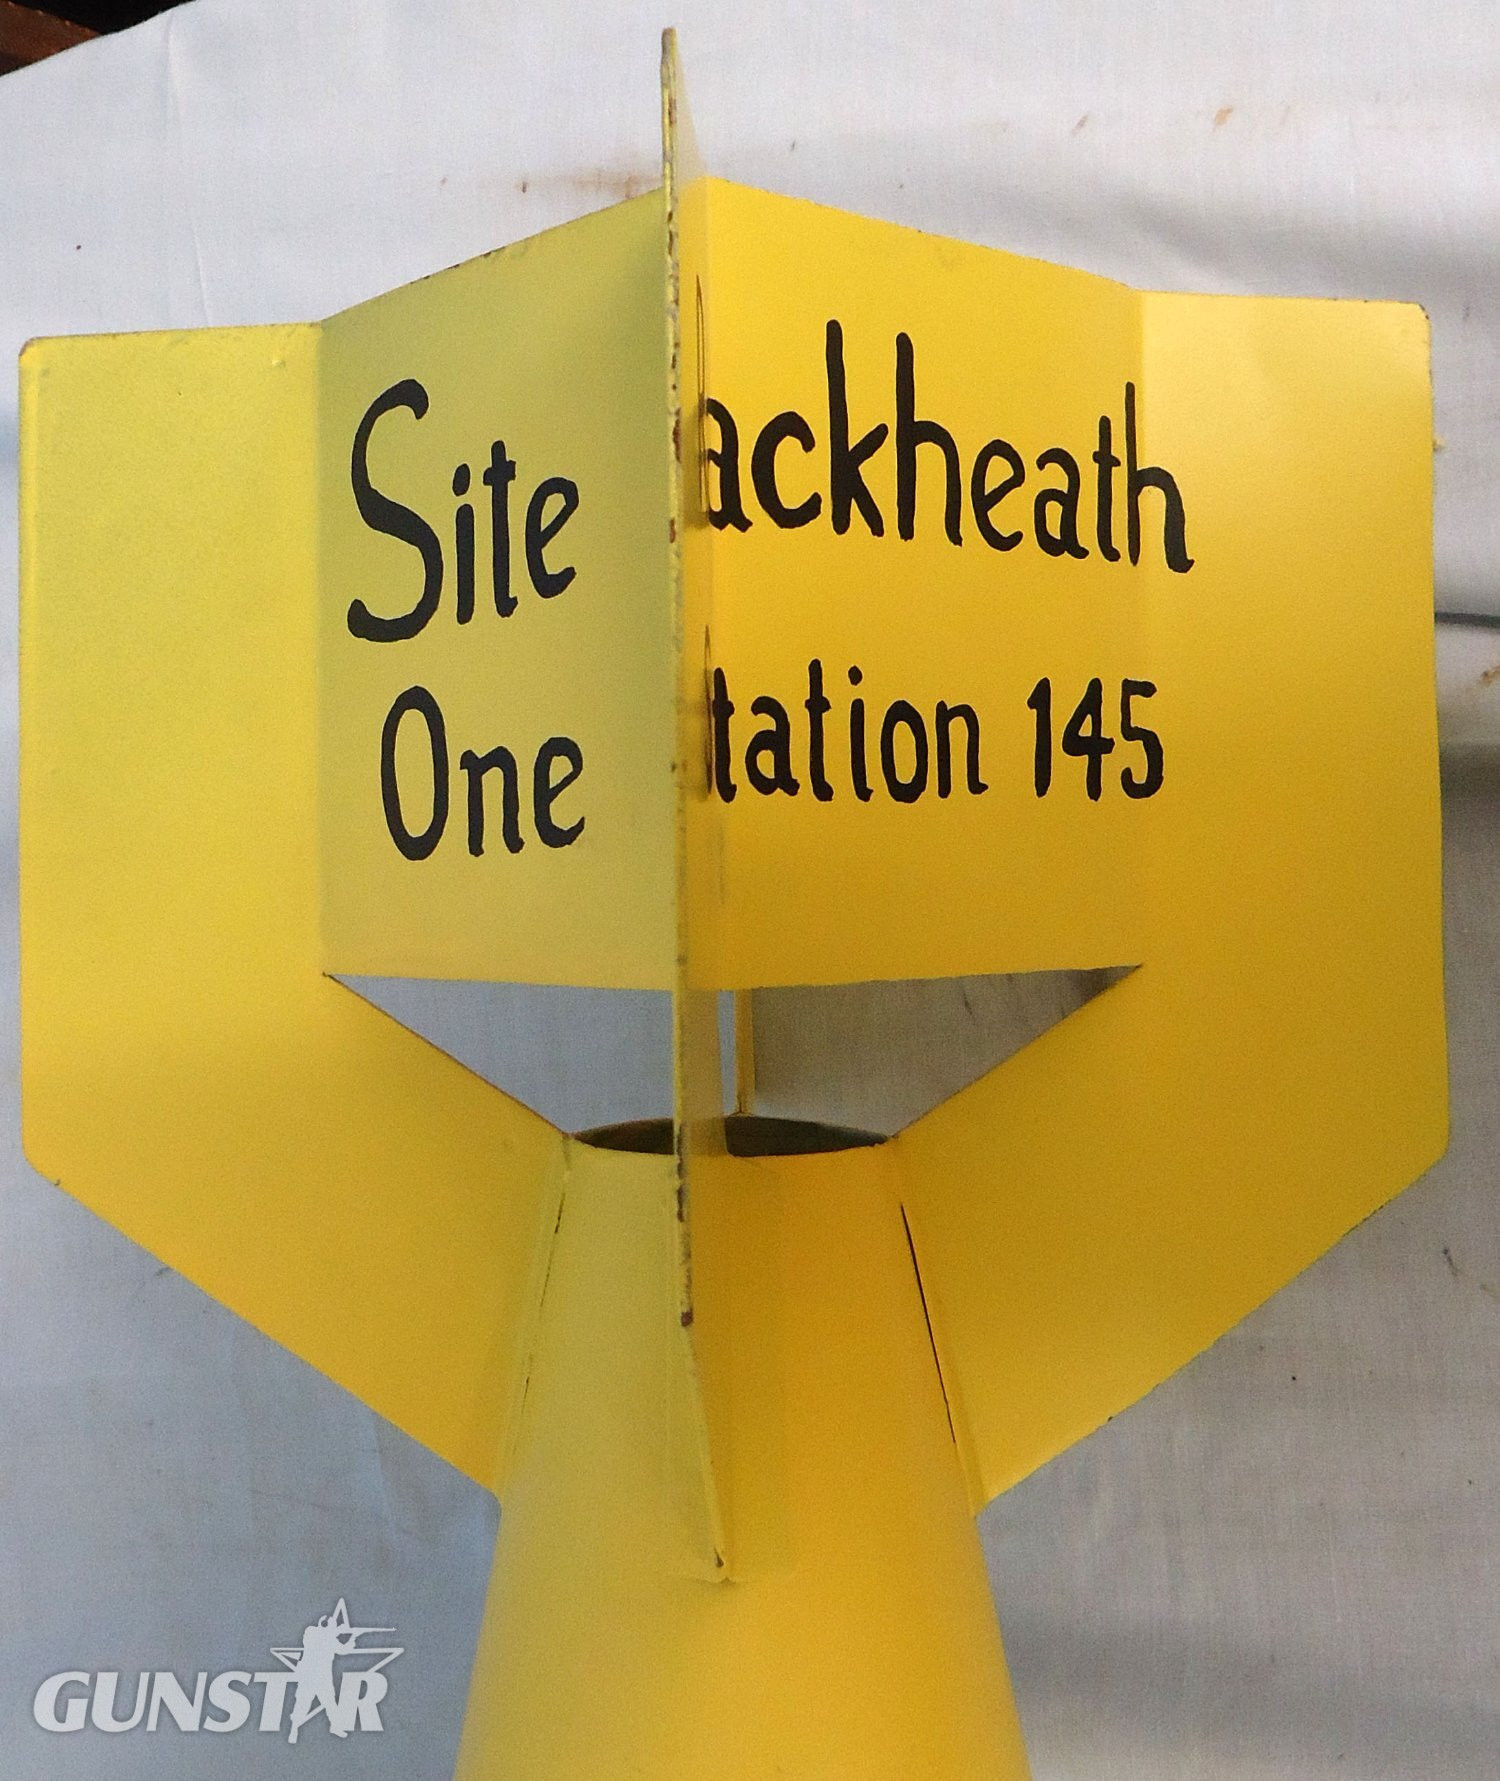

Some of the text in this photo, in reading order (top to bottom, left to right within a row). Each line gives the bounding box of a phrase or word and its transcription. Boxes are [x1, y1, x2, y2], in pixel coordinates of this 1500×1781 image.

[347, 378, 580, 643] Site
[706, 319, 1196, 574] ackheath
[380, 685, 586, 861] One
[710, 658, 1164, 804] tation 145
